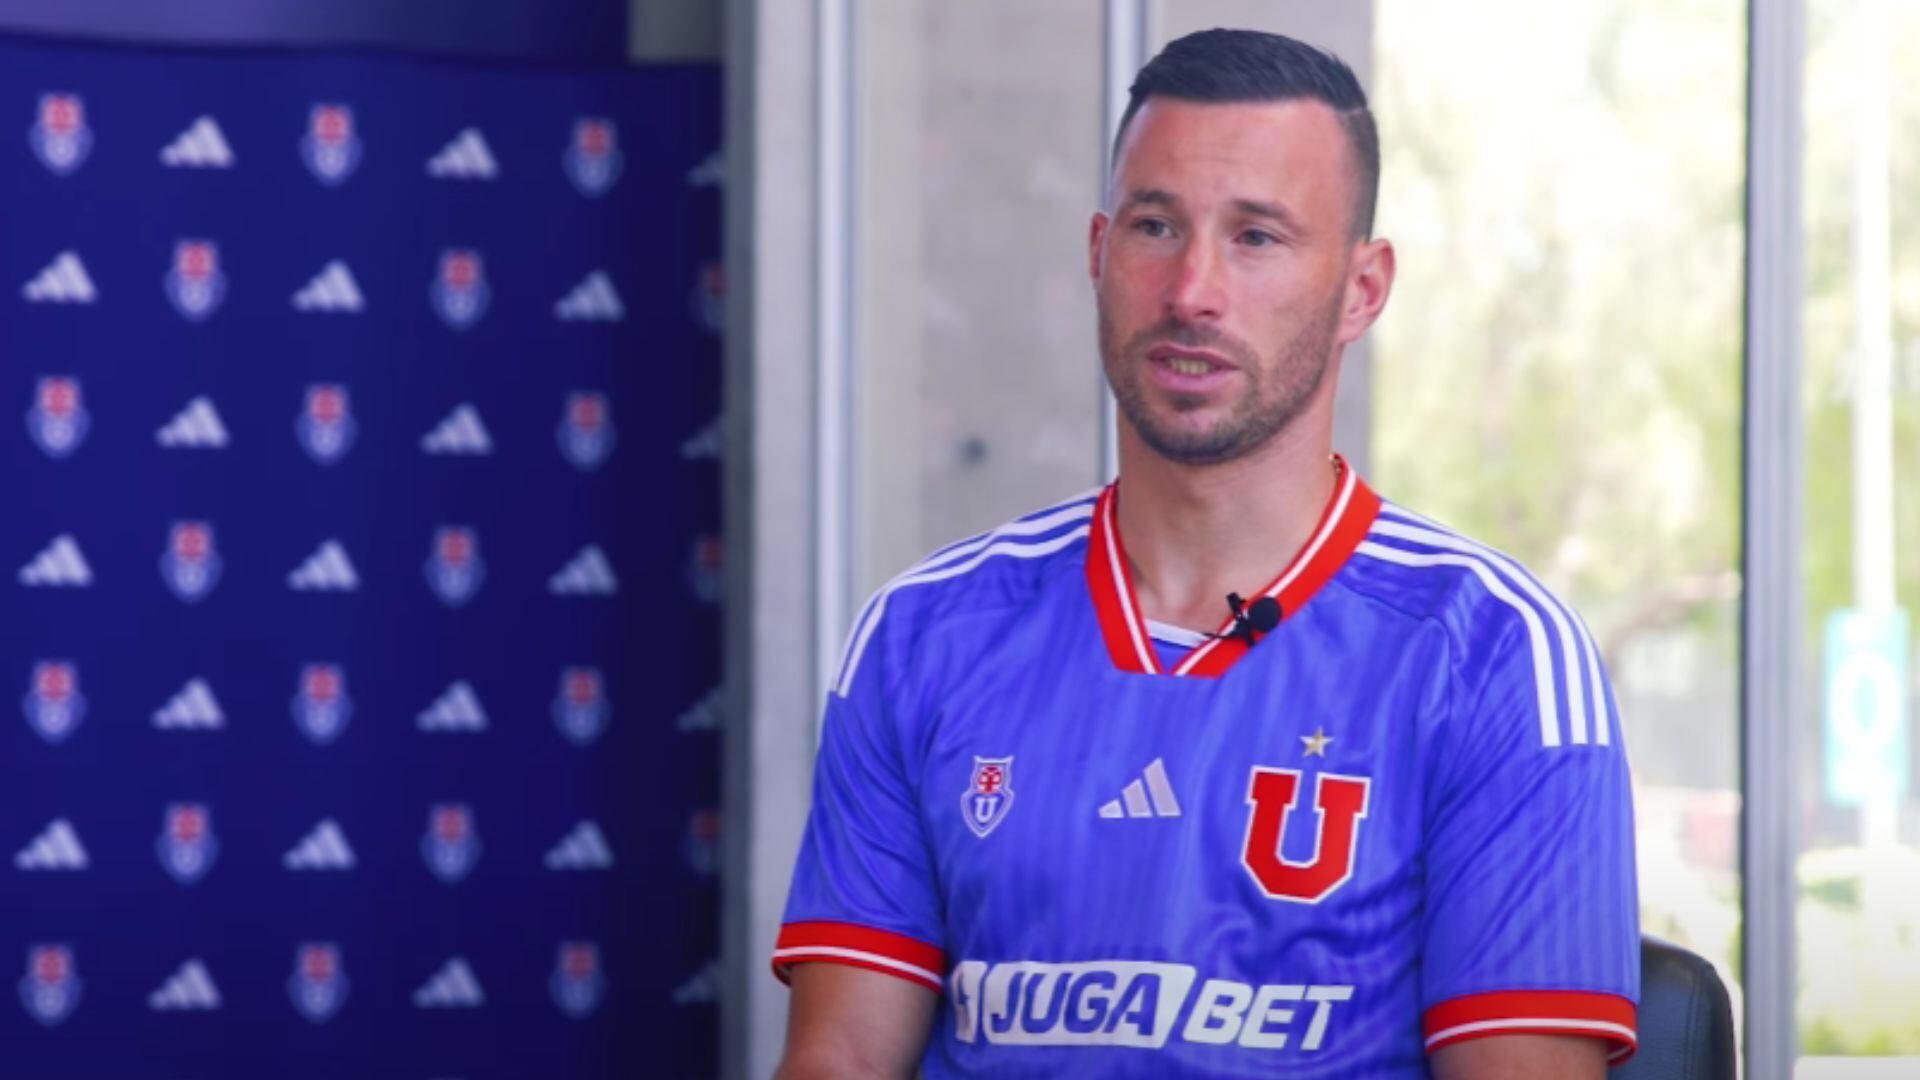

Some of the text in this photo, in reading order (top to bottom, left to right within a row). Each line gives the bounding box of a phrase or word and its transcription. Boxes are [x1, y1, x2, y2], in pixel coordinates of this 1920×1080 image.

[975, 797, 998, 823] U
[1241, 766, 1370, 904] U
[990, 970, 1354, 1050] JUGA BET
